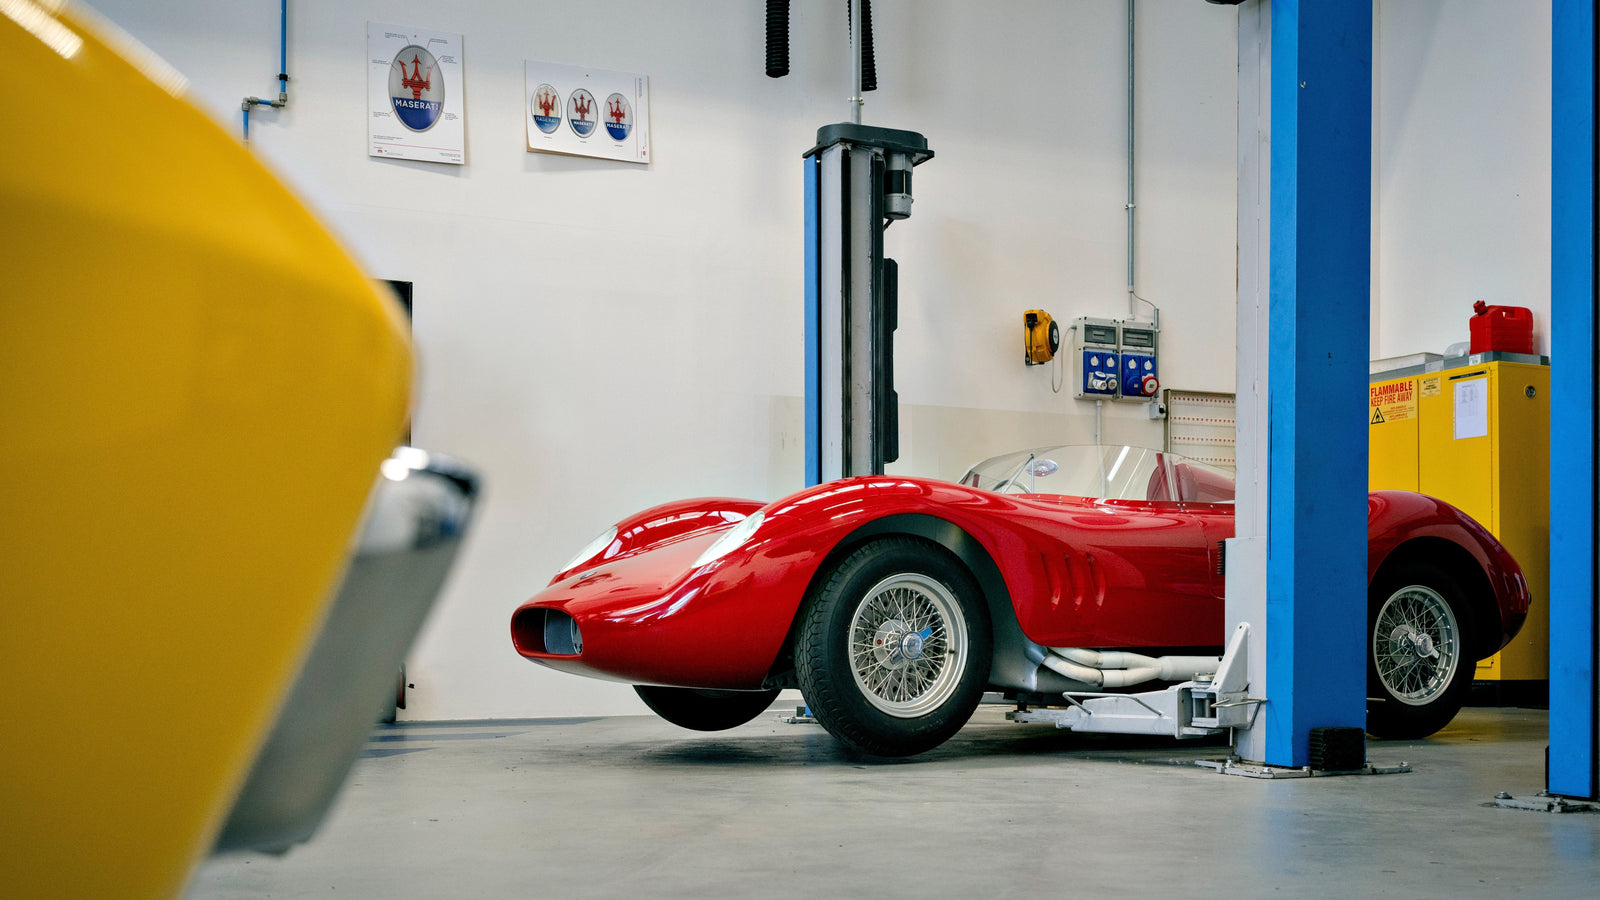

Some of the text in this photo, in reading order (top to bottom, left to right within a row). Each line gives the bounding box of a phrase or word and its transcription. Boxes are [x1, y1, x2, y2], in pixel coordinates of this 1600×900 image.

[395, 99, 439, 110] MASERATI
[1370, 380, 1413, 397] FLAMMABLE
[1371, 395, 1383, 407] KEEP
[1384, 393, 1396, 406] FIRE
[1397, 390, 1413, 403] AWAY
